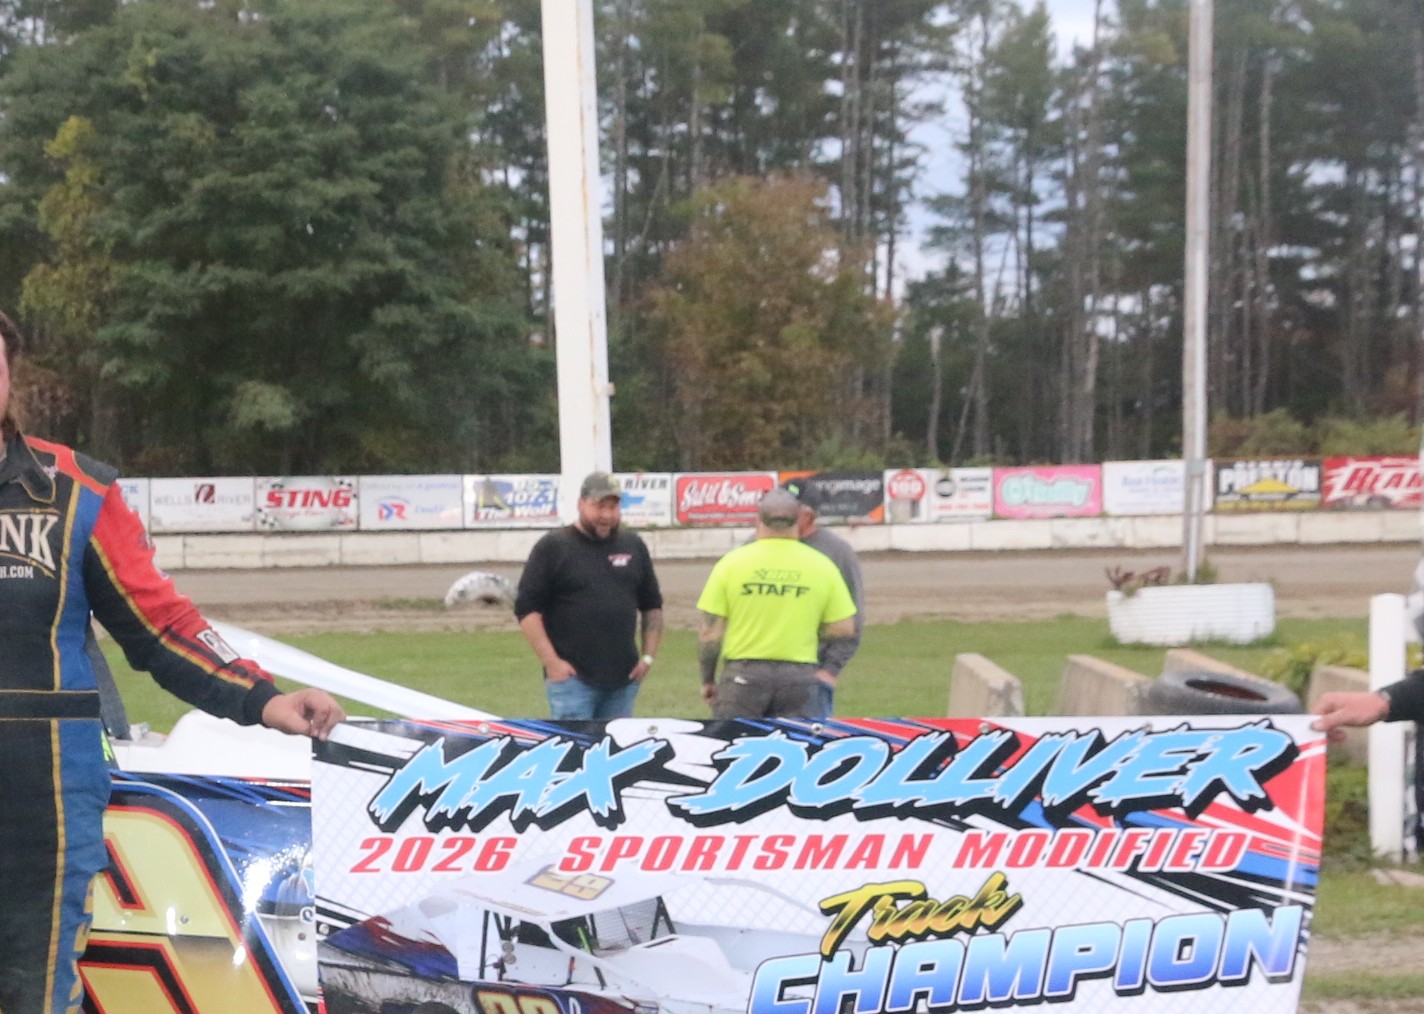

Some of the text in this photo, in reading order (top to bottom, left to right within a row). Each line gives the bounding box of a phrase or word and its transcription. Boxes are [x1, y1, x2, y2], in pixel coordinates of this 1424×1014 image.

[265, 488, 353, 508] STING
[624, 478, 668, 489] RIVER
[741, 583, 811, 598] STAFF
[369, 719, 1298, 829] MAX DOLLIVER
[349, 828, 1251, 874] 2026 SPORTSMAN MODIFIED
[819, 871, 1023, 957] Track
